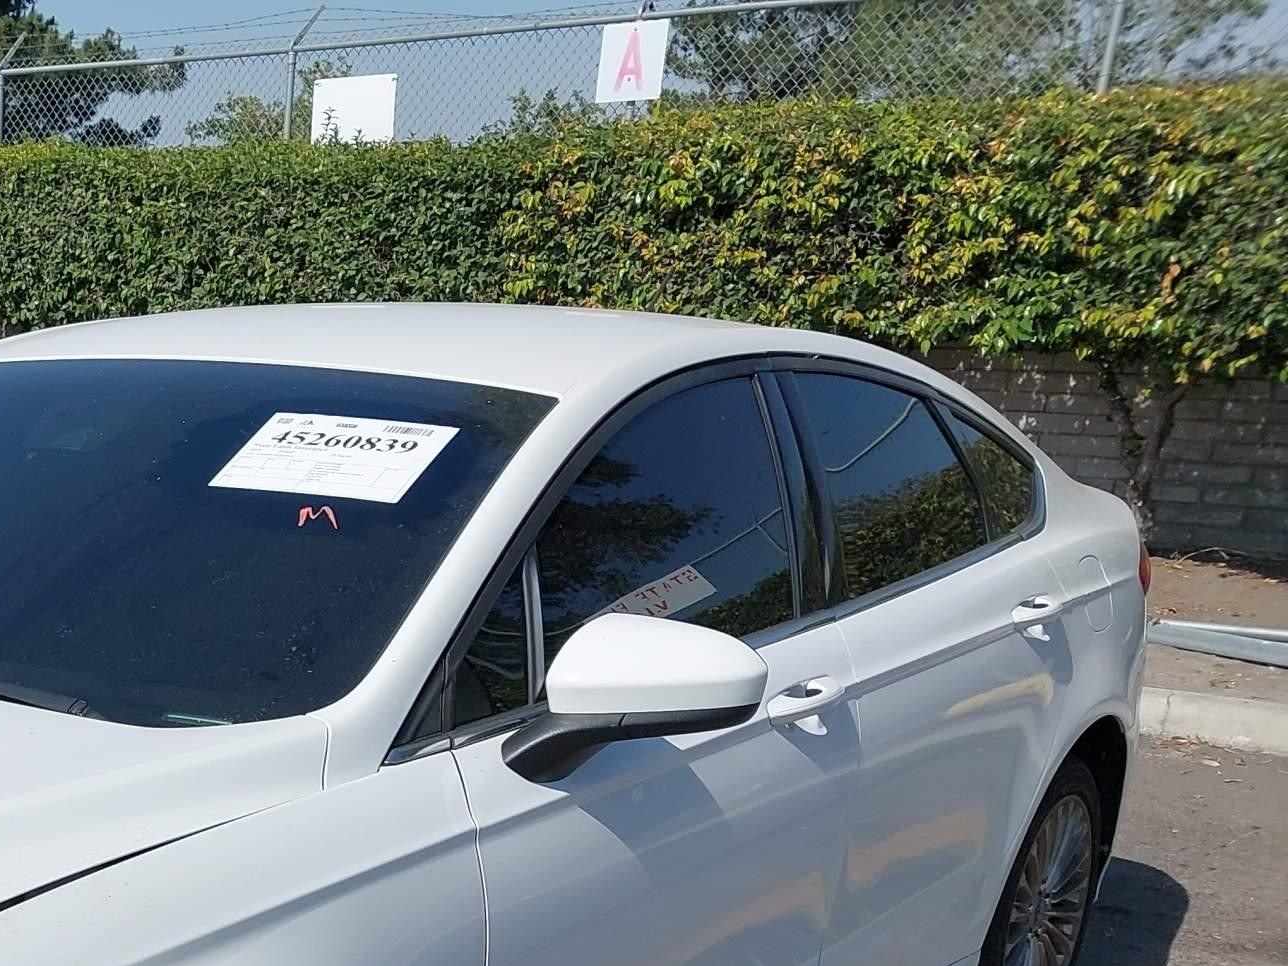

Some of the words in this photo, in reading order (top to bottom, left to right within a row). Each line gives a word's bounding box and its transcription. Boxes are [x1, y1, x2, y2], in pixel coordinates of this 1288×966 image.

[613, 31, 644, 92] A
[271, 430, 418, 454] 45260839
[298, 506, 338, 530] M
